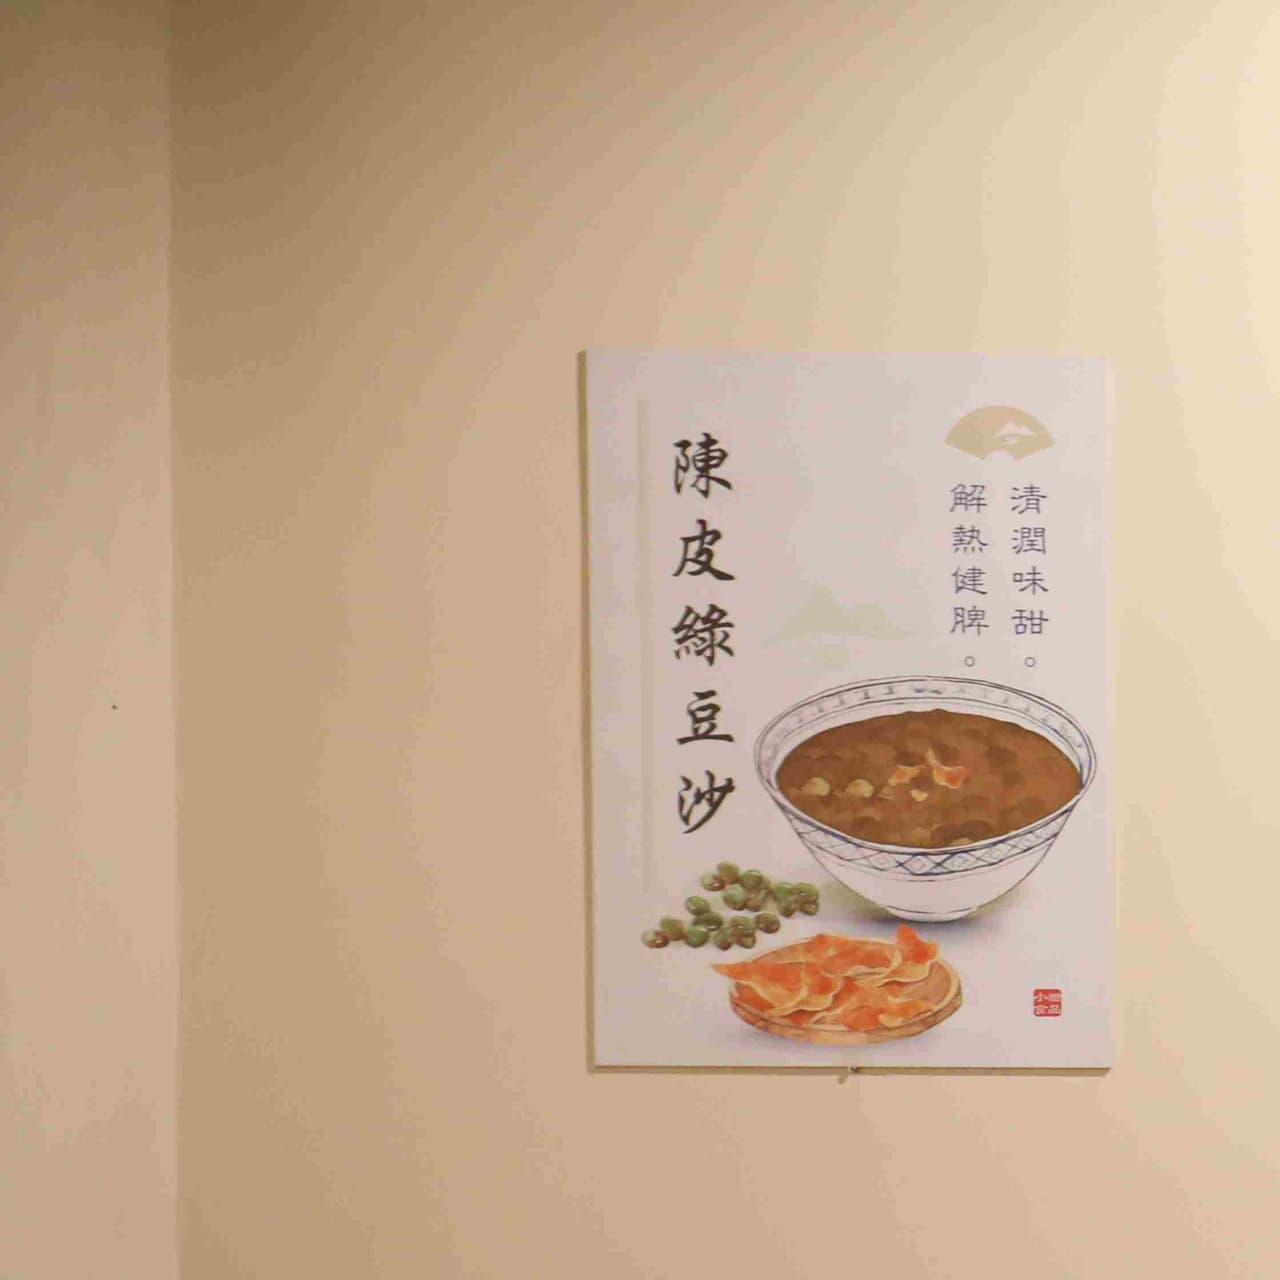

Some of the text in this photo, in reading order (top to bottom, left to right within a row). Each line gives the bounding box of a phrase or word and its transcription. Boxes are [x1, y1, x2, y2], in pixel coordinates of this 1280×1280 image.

[671, 432, 736, 834] 陳皮綠豆沙
[950, 483, 989, 667] 解熱健脾。
[1010, 484, 1050, 667] 清潤味甜。
